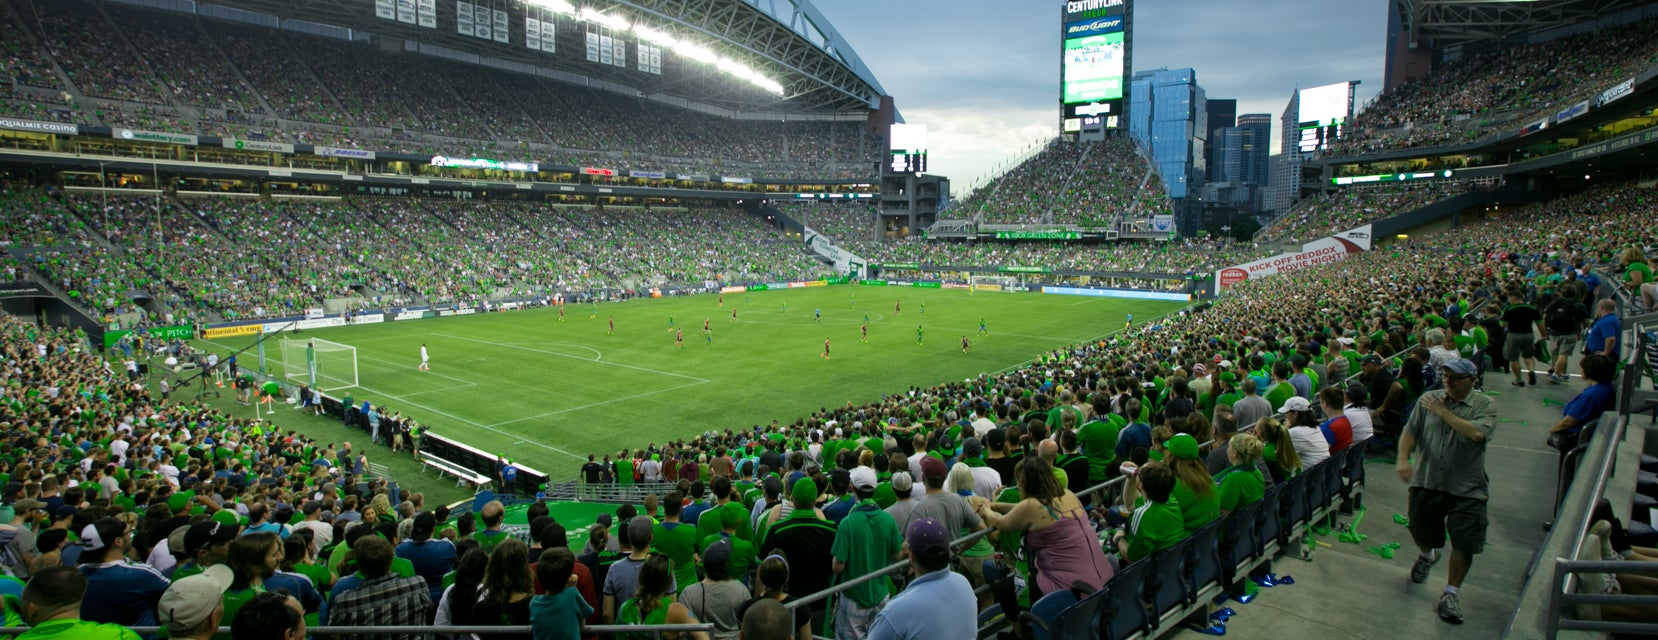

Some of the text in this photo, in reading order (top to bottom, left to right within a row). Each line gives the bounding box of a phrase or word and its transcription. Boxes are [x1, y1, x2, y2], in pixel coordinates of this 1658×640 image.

[1083, 8, 1107, 19] FIELD
[1068, 25, 1090, 33] BUD
[0, 120, 76, 132] QUALMIE casino
[133, 131, 191, 143] walottery.com
[245, 142, 283, 151] CenturyLink
[1249, 246, 1337, 273] KICK OFF REDBOX
[1277, 261, 1308, 273] MOVIE
[167, 328, 192, 337] PITCH
[205, 327, 239, 337] ntinental
